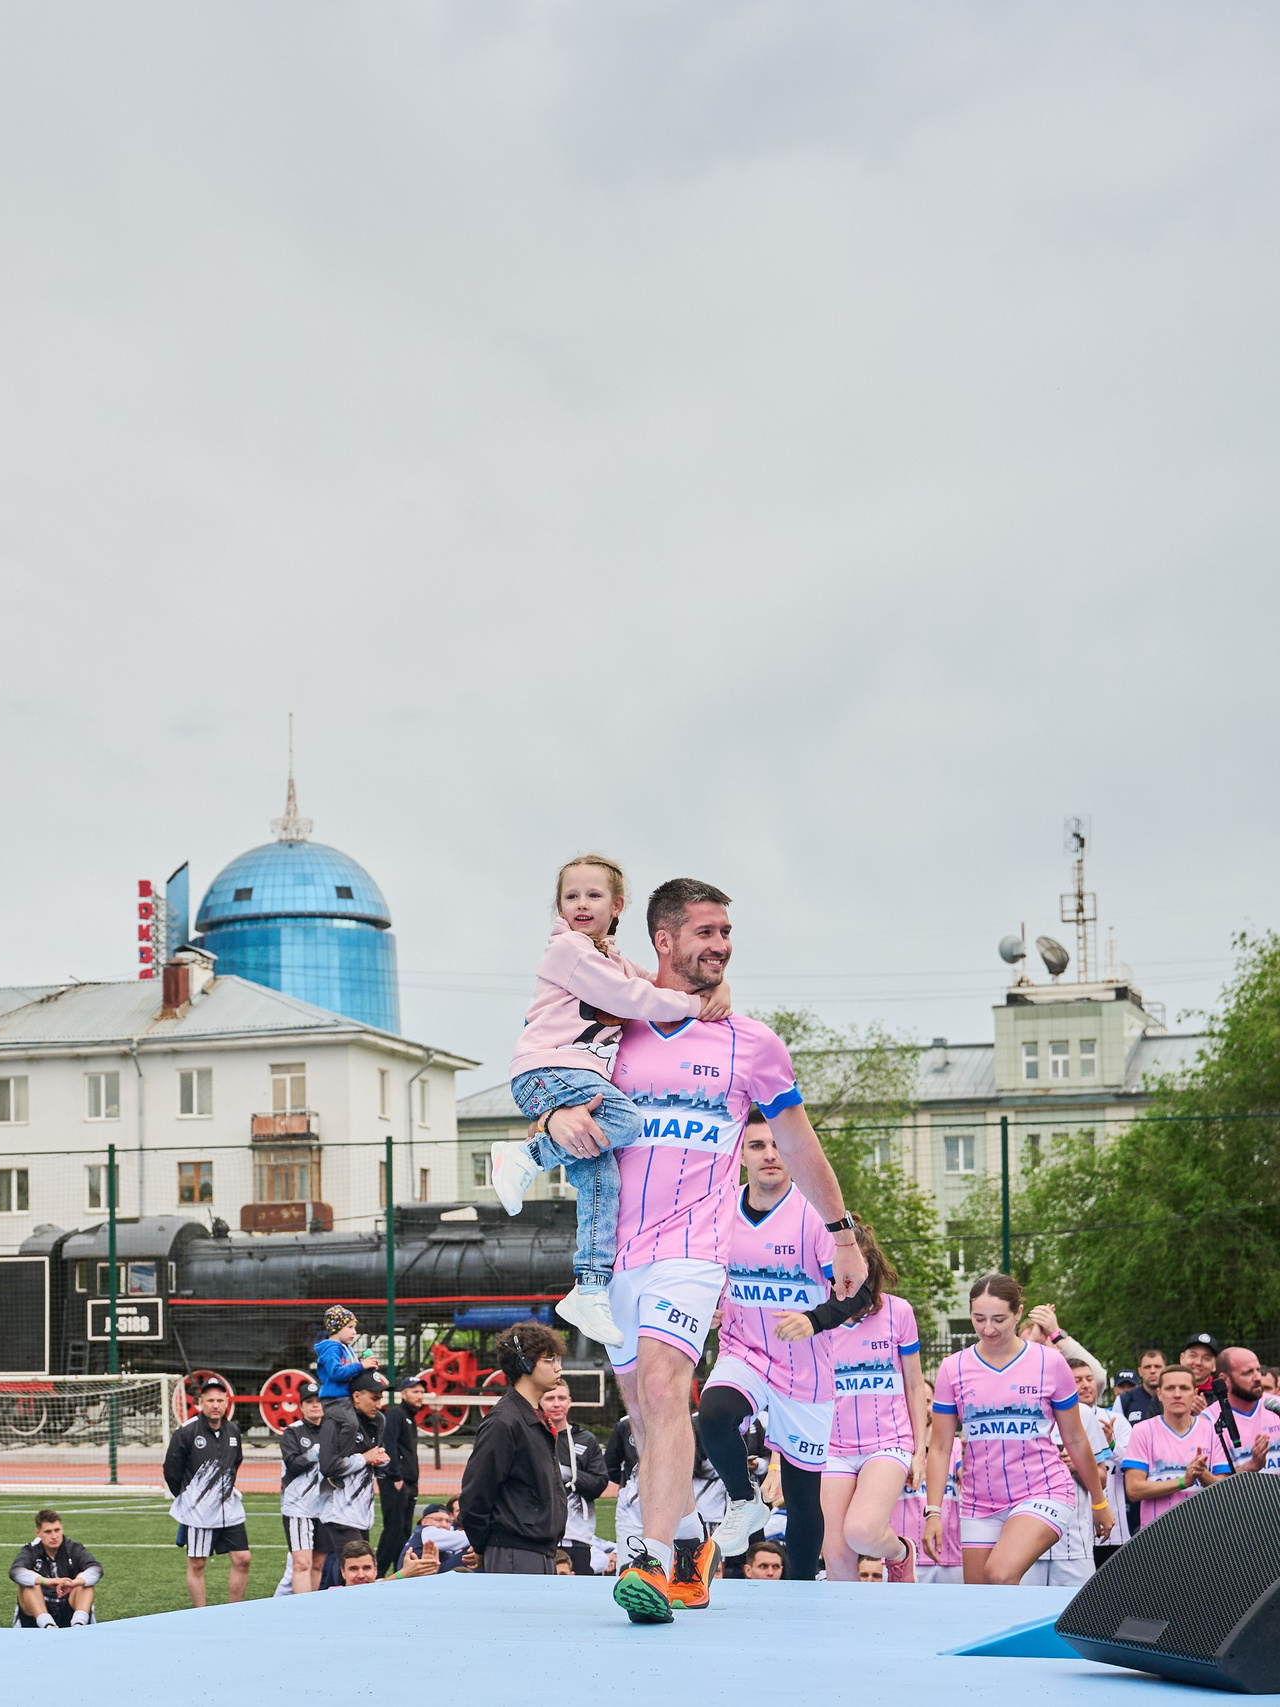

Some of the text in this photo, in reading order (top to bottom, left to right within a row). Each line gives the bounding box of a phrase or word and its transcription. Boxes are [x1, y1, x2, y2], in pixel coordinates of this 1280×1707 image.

[692, 1064, 720, 1078] ВТБ
[638, 1118, 719, 1144] МАРА
[774, 1245, 796, 1255] ВТБ
[668, 1308, 699, 1334] ВТБ
[871, 1340, 889, 1350] ВТБ
[835, 1377, 894, 1391] АМАРА
[1019, 1386, 1038, 1395] ВТБ
[799, 1441, 824, 1456] ВТБ
[1033, 1503, 1058, 1518] ВТБ
